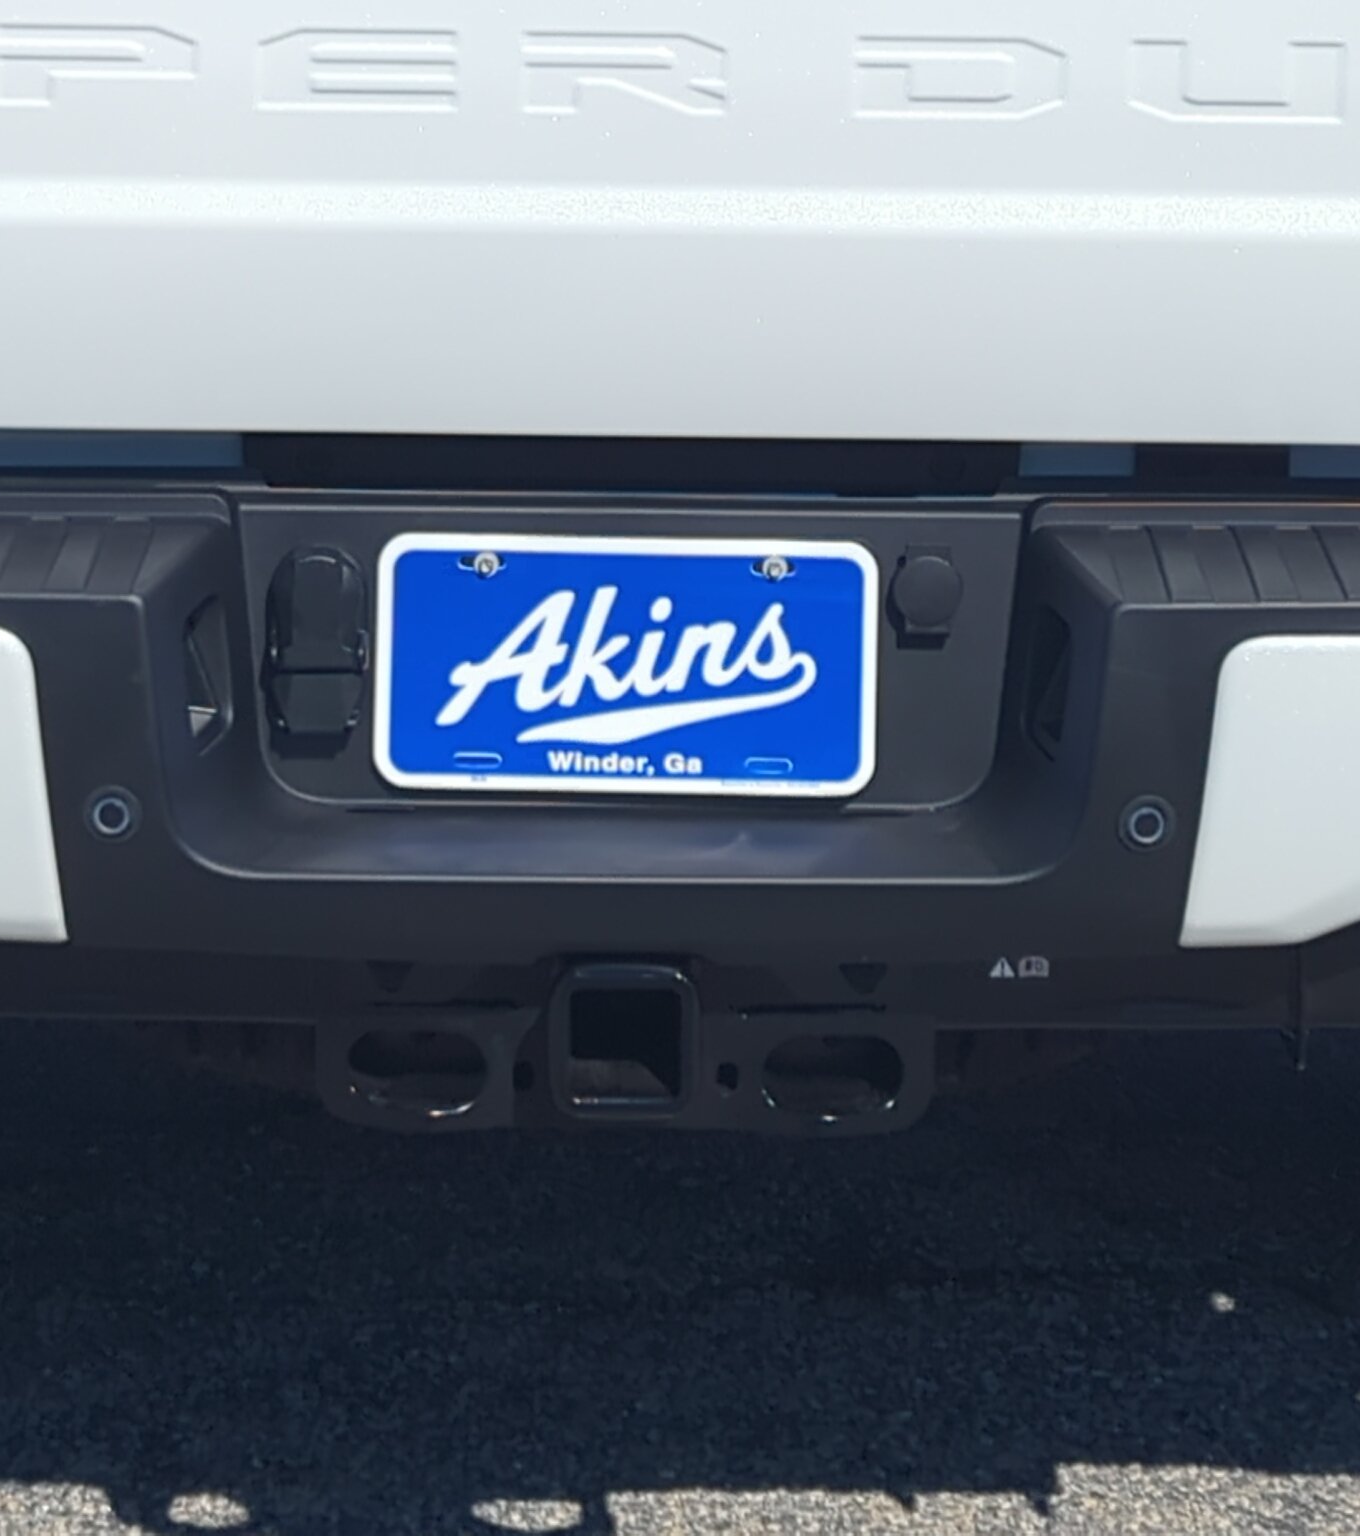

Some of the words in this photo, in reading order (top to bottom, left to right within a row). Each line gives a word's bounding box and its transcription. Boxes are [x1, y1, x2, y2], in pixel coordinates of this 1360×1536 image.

[435, 586, 816, 726] Akins
[547, 750, 655, 777] Winder,
[663, 753, 703, 774] Ga
